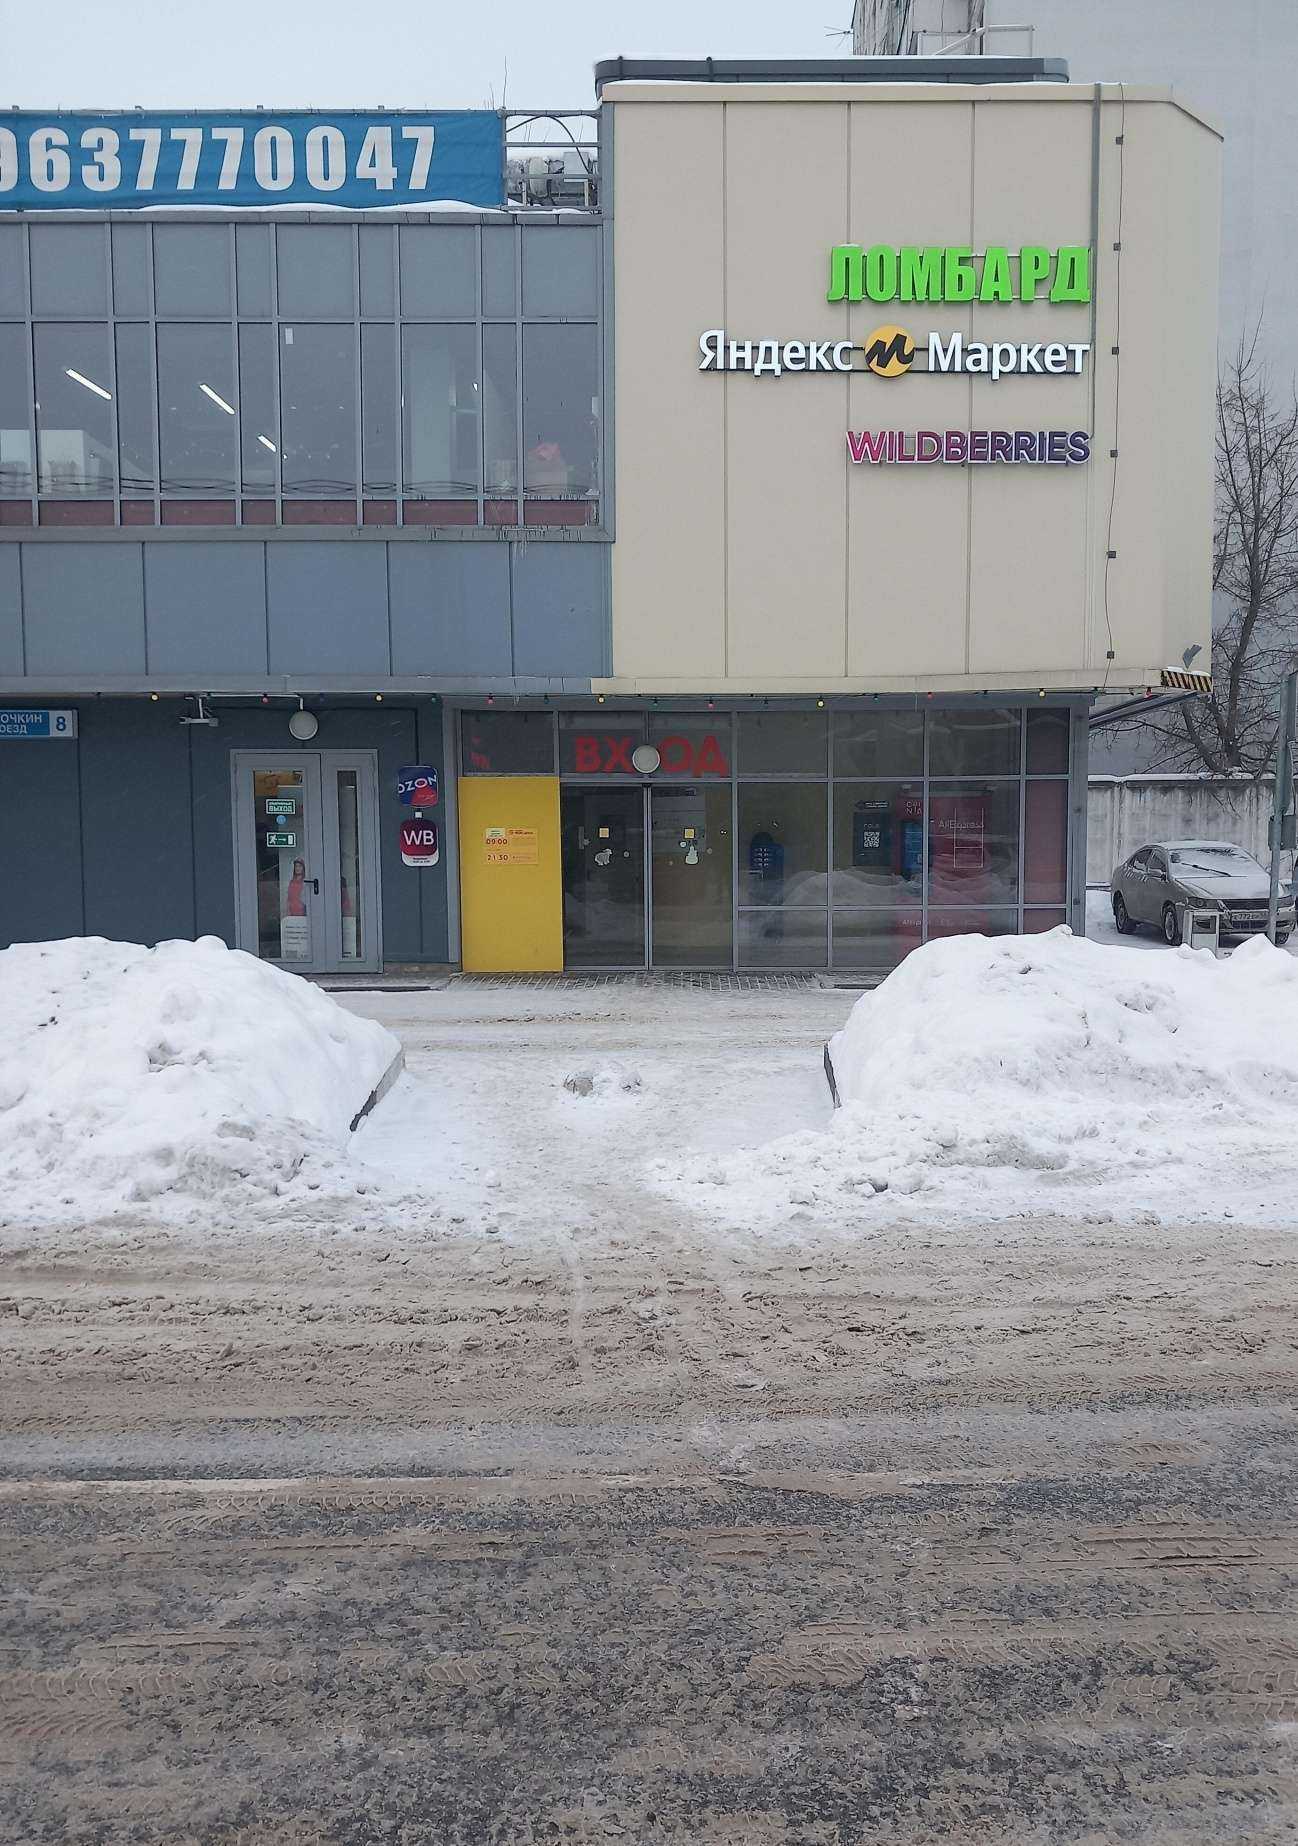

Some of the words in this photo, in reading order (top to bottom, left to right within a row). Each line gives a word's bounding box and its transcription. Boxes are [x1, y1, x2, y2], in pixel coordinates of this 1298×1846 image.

[826, 244, 1092, 303] ЛОМБАРД
[698, 329, 854, 377] Яндекс
[927, 332, 1091, 380] Маркет
[847, 430, 1091, 465] WILDBERRIES
[0, 713, 42, 724] ОЧКИН
[56, 716, 66, 731] 8
[575, 735, 729, 778] ВХОД
[398, 774, 437, 794] OZON
[403, 830, 435, 845] WB
